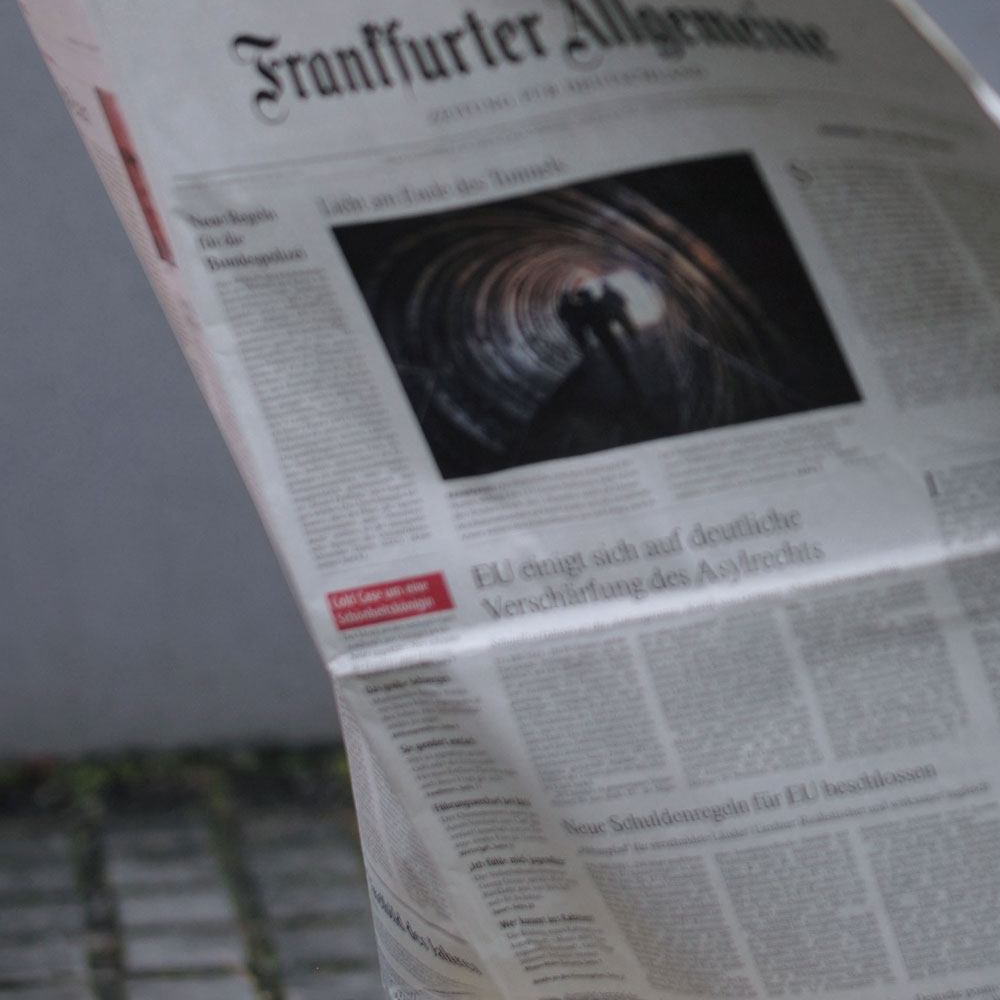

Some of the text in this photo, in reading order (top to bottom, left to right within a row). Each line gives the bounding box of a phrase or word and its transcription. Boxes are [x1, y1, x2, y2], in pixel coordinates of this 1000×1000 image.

[232, 10, 547, 124] Frankfurter
[474, 510, 802, 588] EU einigt sich auf deutliche
[482, 541, 825, 617] Verschärfung des Asylrechts
[562, 817, 606, 835] Neue
[608, 797, 750, 834] Schuldenregeln
[751, 790, 783, 812] für
[786, 782, 818, 805] EU
[823, 763, 938, 797] beschlossen
